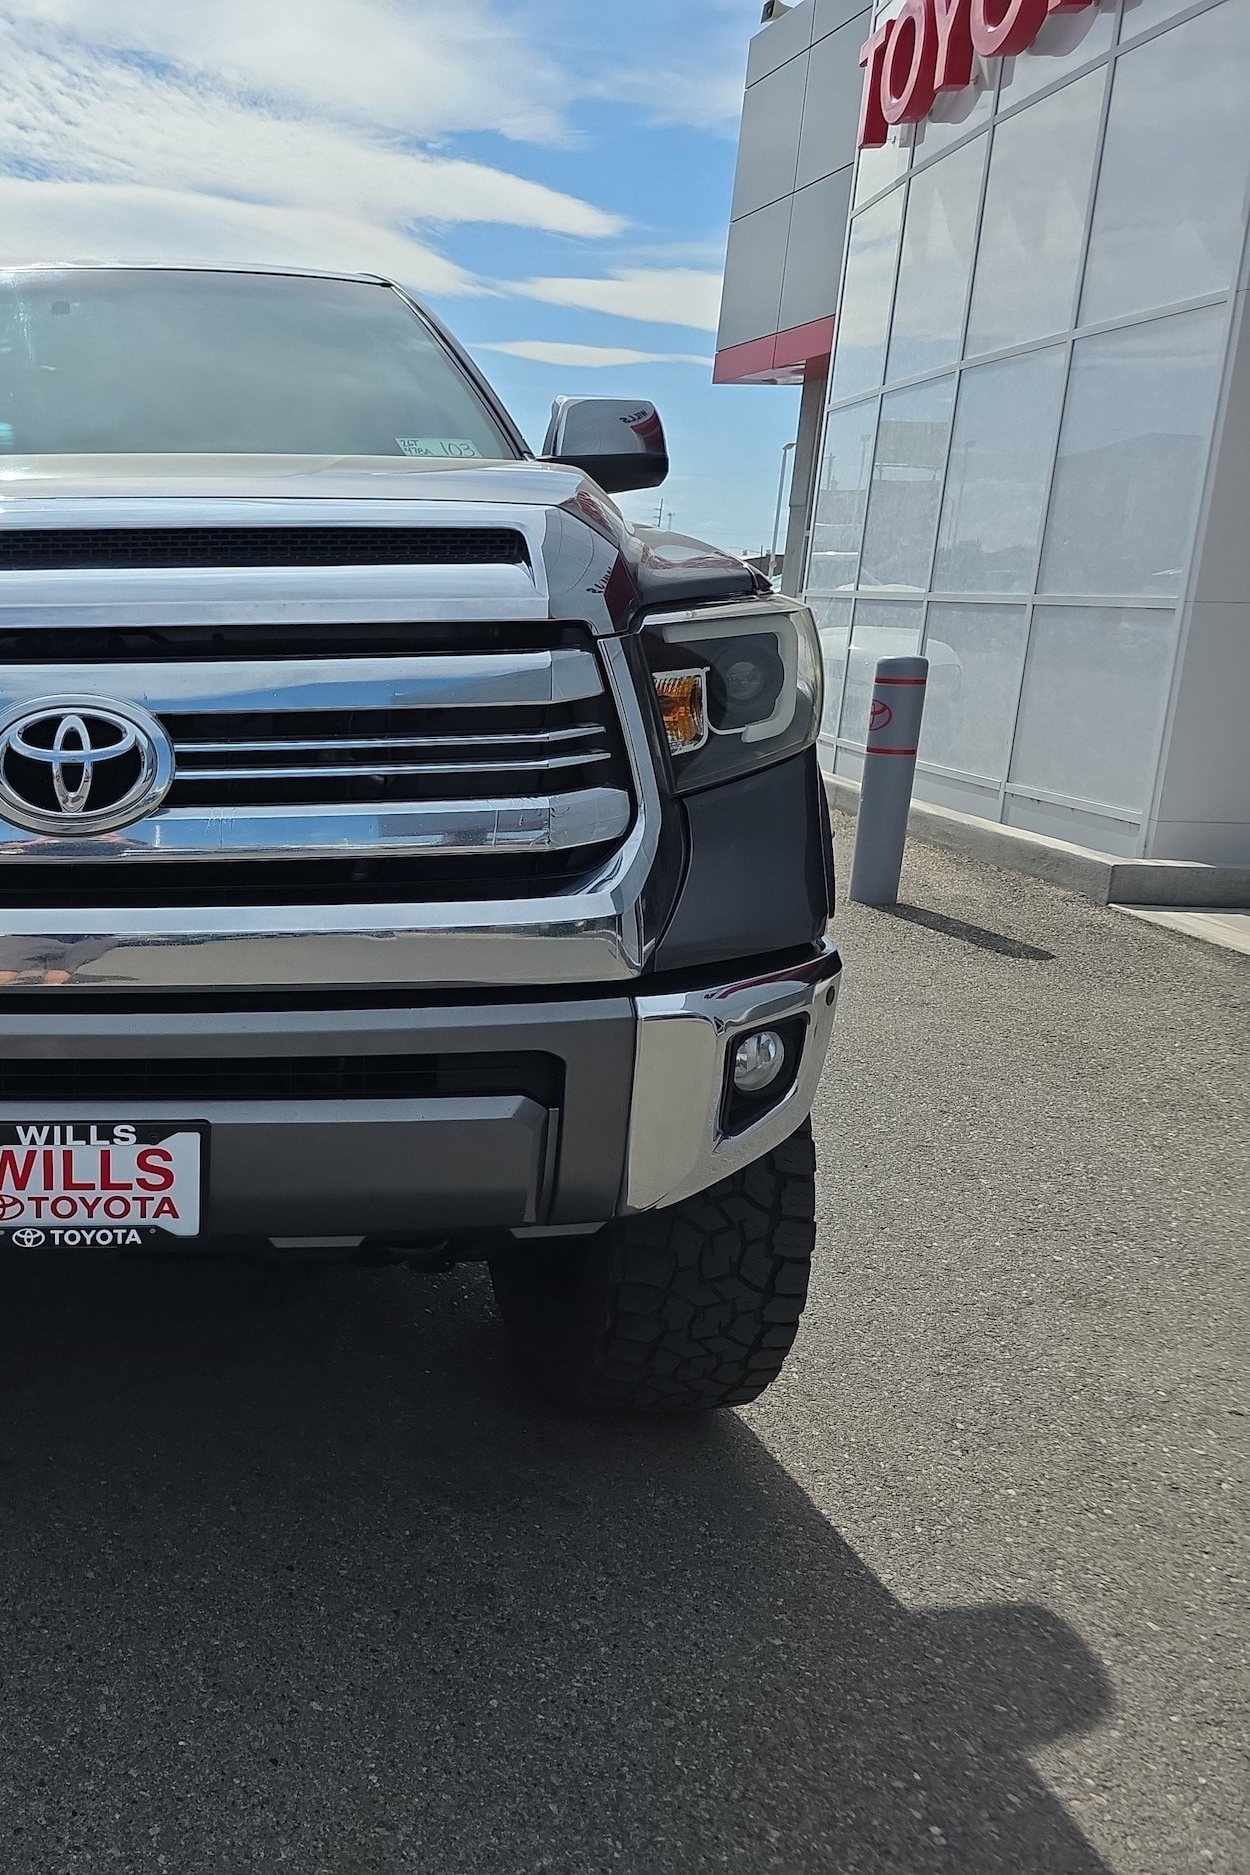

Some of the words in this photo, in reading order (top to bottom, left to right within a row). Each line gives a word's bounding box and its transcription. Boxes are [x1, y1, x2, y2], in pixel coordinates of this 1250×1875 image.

[858, 0, 1092, 149] TOY
[440, 441, 476, 457] 103
[16, 1124, 137, 1146] WILLS
[27, 1195, 180, 1219] TOYOTA
[50, 1229, 142, 1246] TOYOTA
